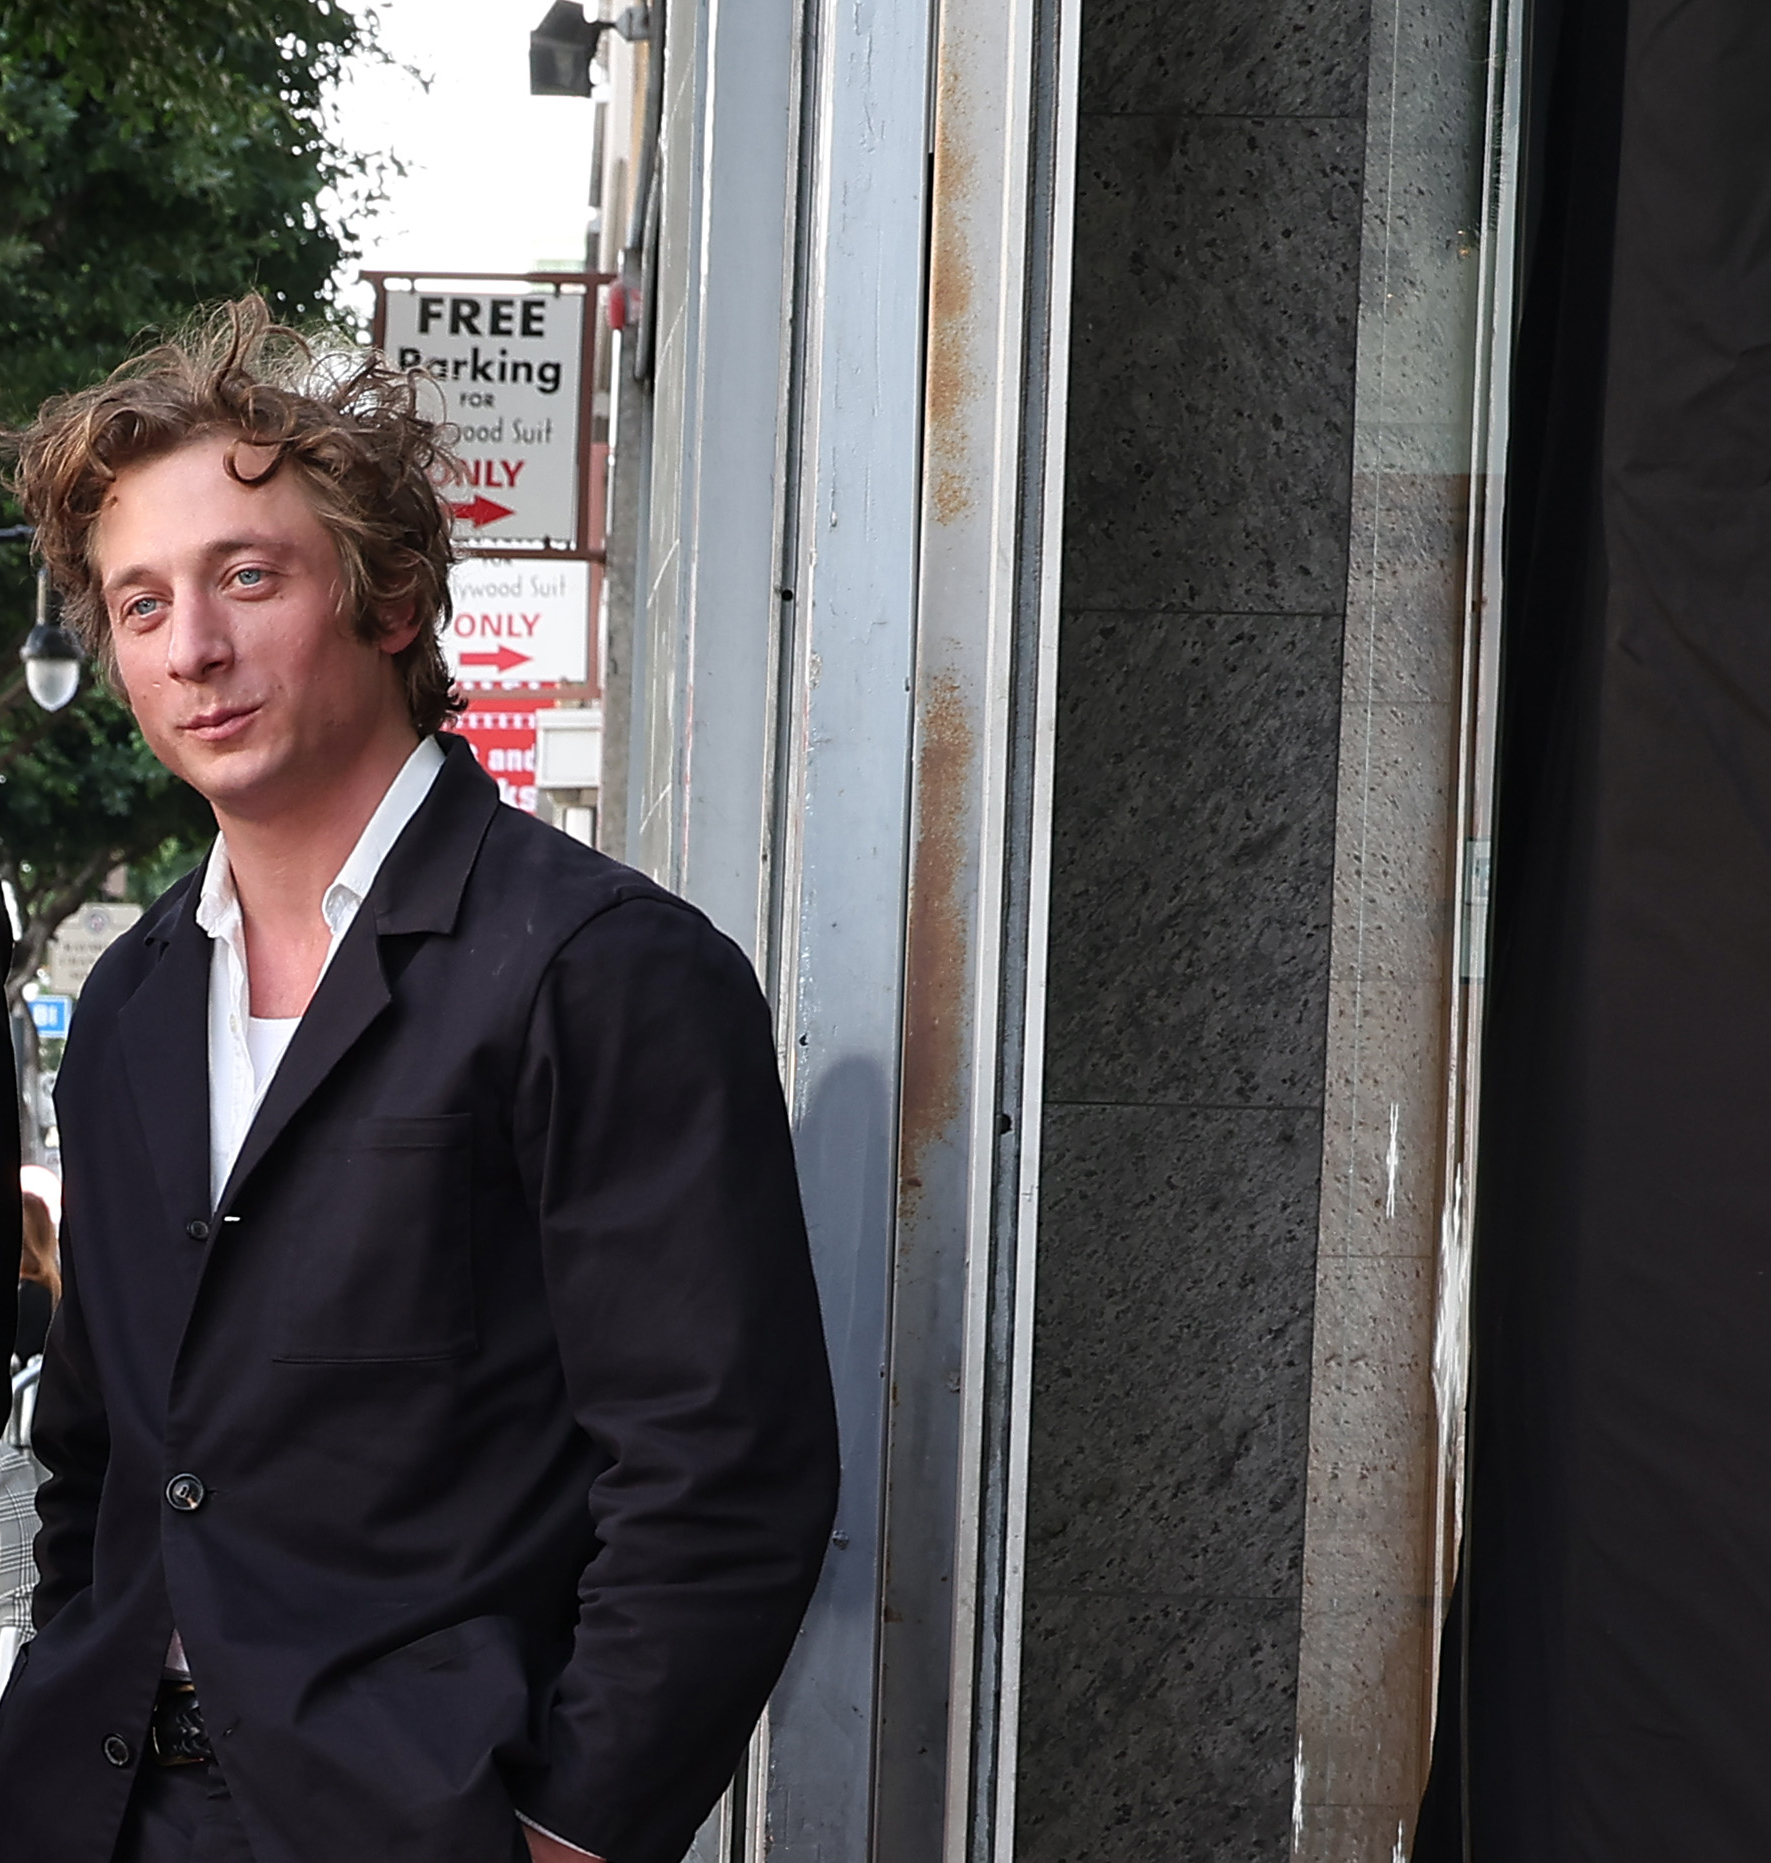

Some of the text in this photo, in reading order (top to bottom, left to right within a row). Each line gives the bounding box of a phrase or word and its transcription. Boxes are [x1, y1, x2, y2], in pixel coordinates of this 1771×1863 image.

[418, 296, 546, 337] FREE
[397, 346, 562, 395] Parking
[459, 392, 495, 409] FOR
[512, 416, 554, 444] Suit
[425, 458, 525, 488] ONLY
[452, 574, 566, 602] lywood Suit
[453, 612, 541, 638] ONLY
